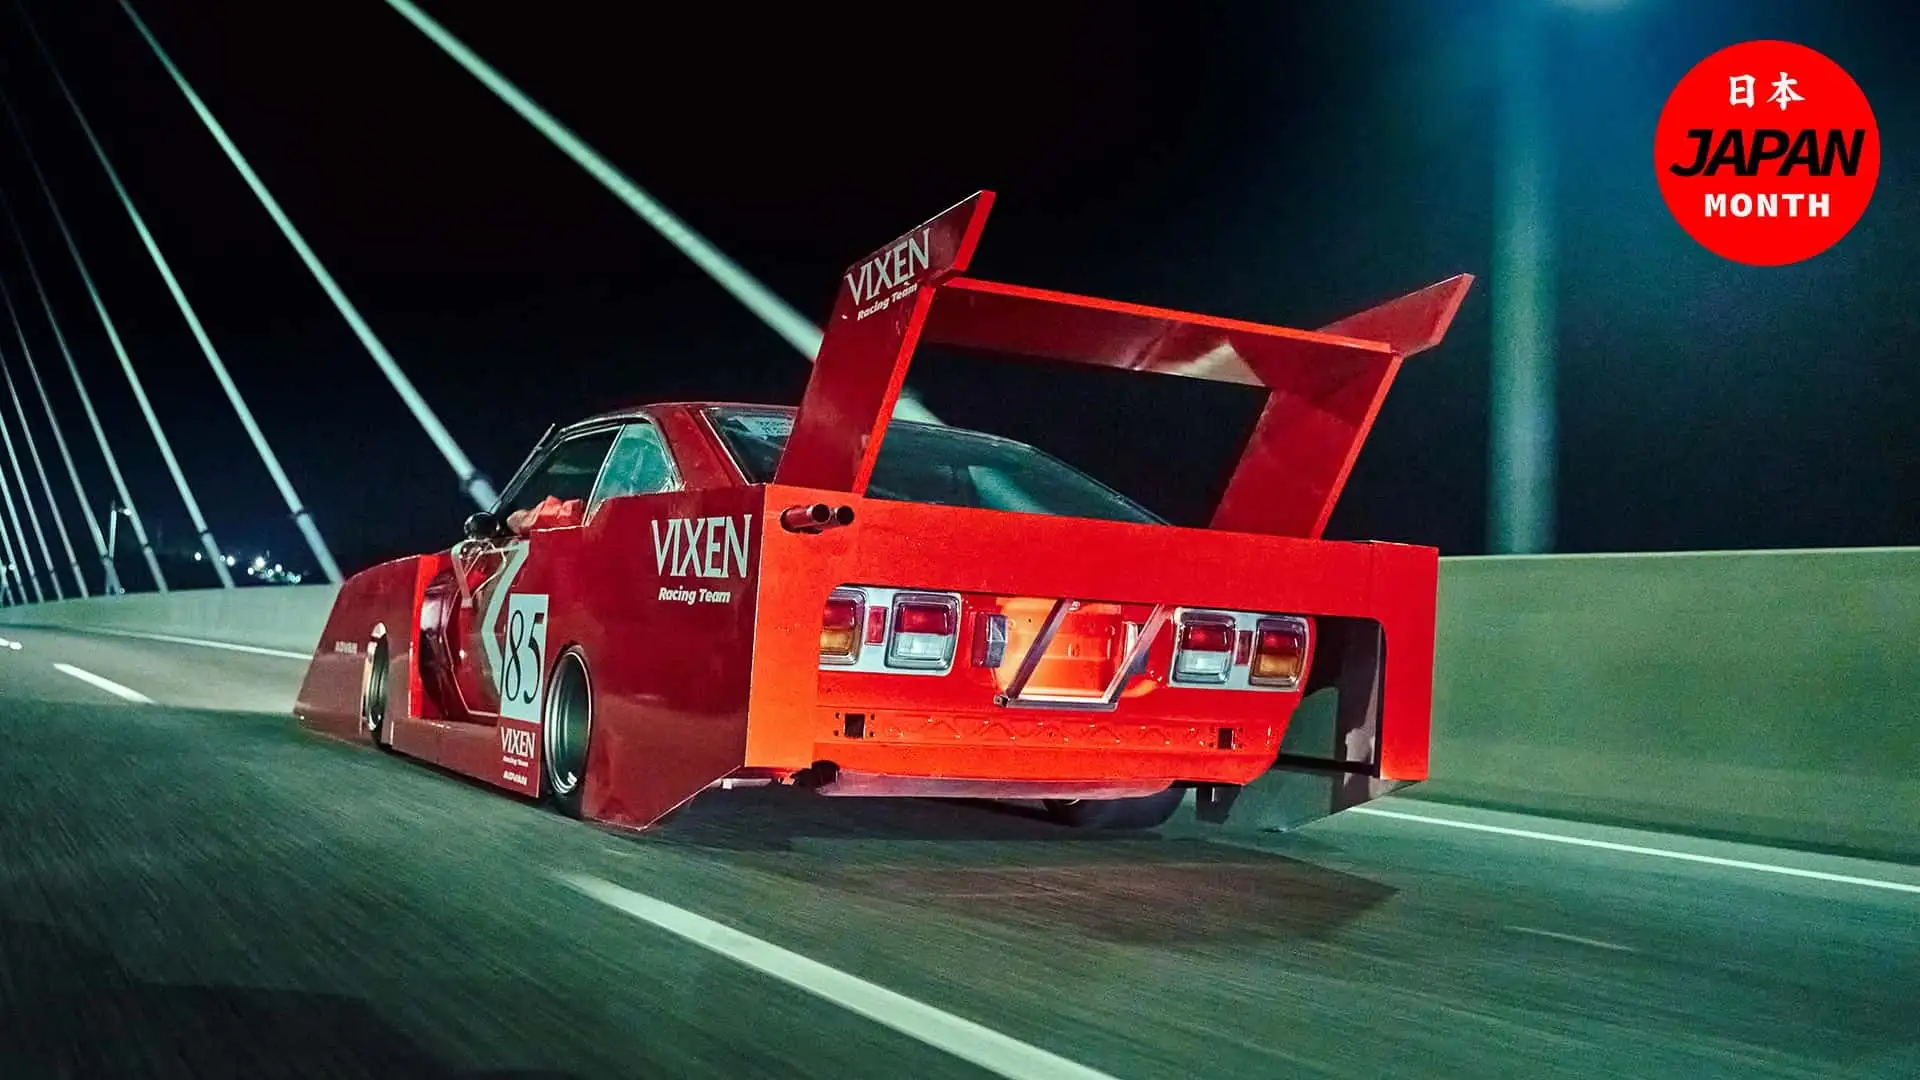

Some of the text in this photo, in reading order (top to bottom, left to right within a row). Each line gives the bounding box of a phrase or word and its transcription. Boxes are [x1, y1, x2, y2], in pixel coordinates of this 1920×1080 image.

[843, 227, 930, 306] VIXEN
[857, 282, 918, 321] Racing Team
[651, 513, 752, 578] VIXEN
[658, 585, 731, 606] Racing Team
[504, 609, 545, 704] 85
[500, 726, 536, 759] VIXEN
